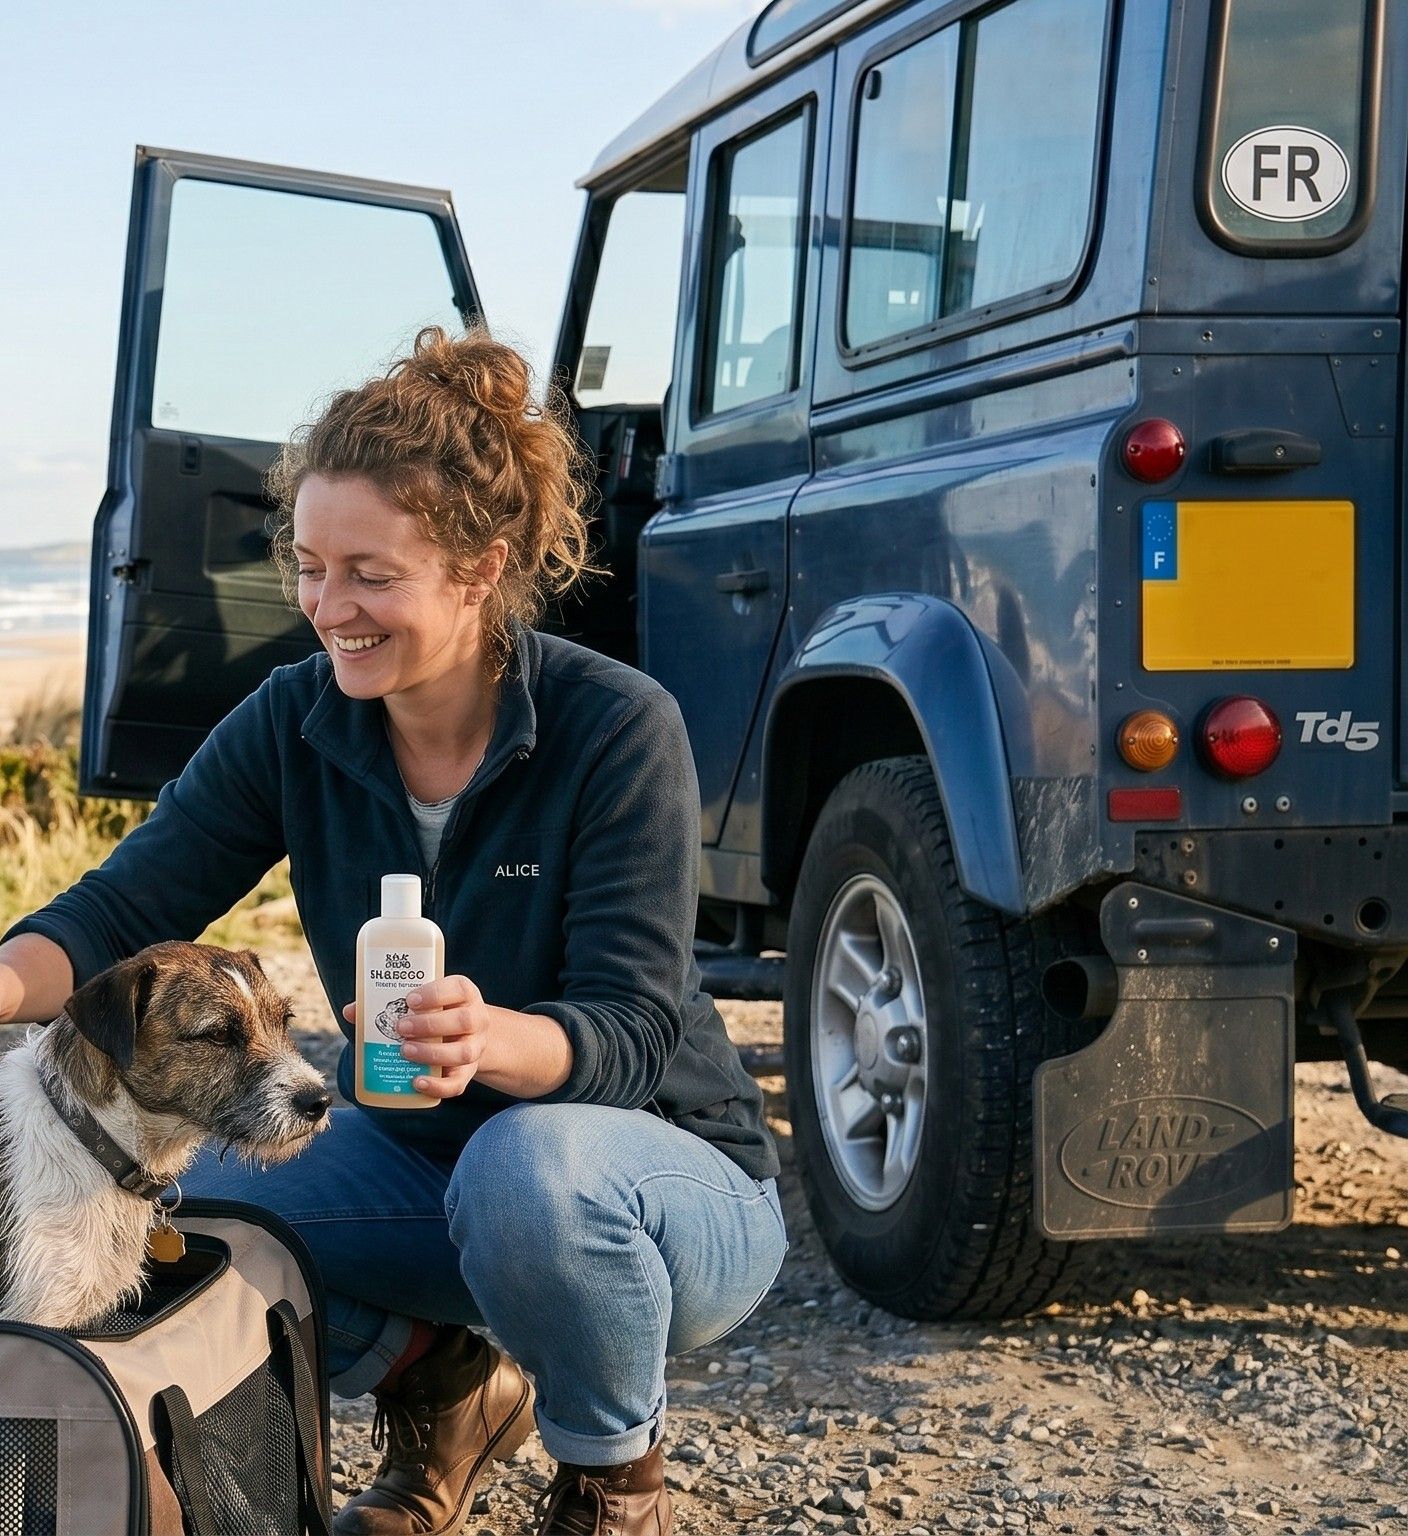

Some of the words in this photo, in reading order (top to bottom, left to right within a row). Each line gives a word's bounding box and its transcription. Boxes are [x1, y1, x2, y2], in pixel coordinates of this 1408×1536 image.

[1252, 145, 1322, 202] FR
[1154, 551, 1165, 569] F
[1295, 711, 1380, 751] Td5
[494, 864, 540, 877] ALICE
[1099, 1113, 1210, 1150] LAND
